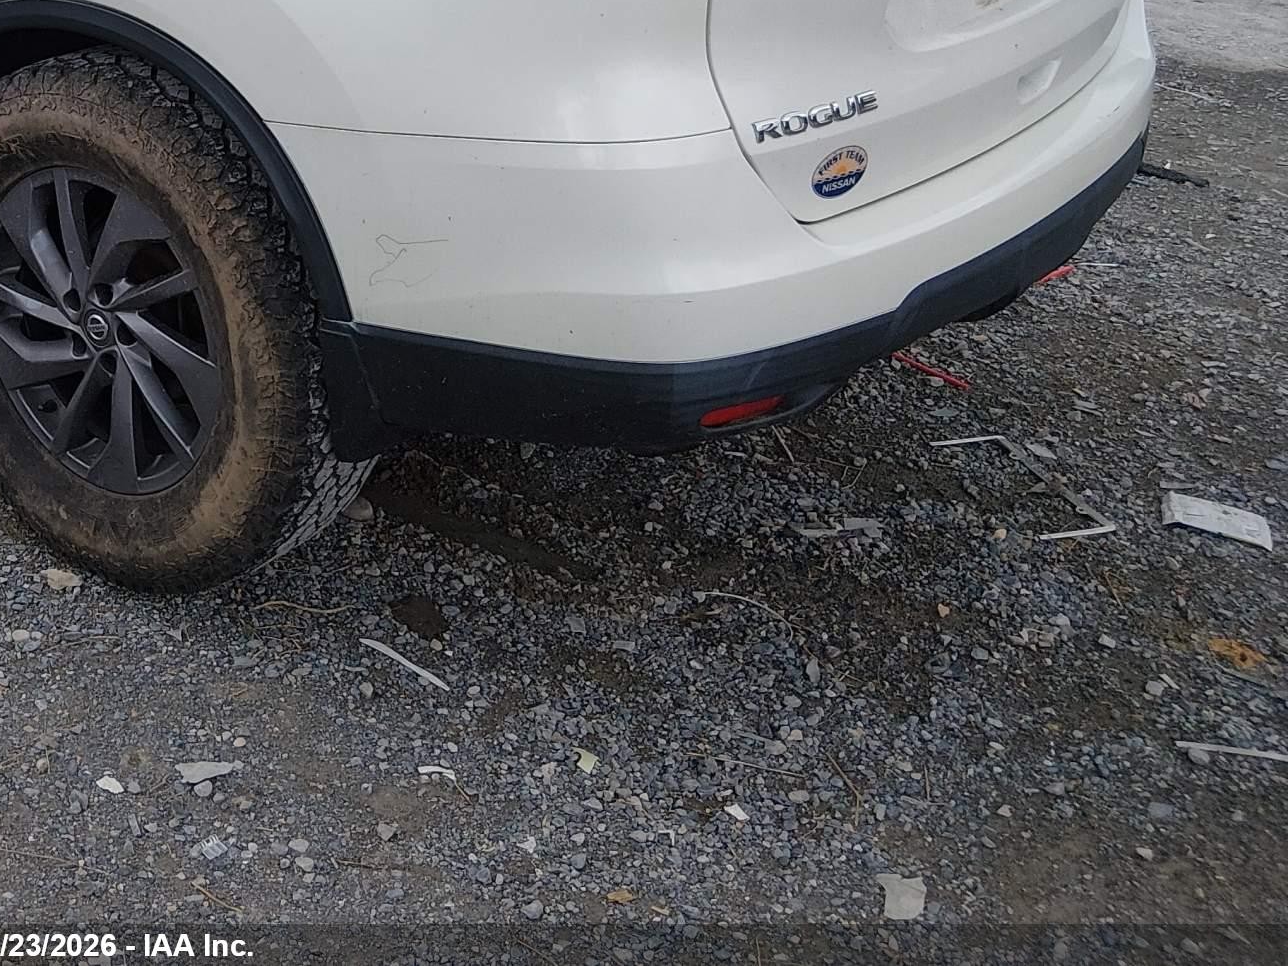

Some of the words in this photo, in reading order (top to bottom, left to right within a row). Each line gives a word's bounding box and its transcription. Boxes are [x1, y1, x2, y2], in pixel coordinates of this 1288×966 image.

[752, 89, 879, 144] ROGUE
[818, 151, 844, 176] FIRST
[845, 150, 865, 166] TEAM
[822, 176, 856, 194] NISSAN
